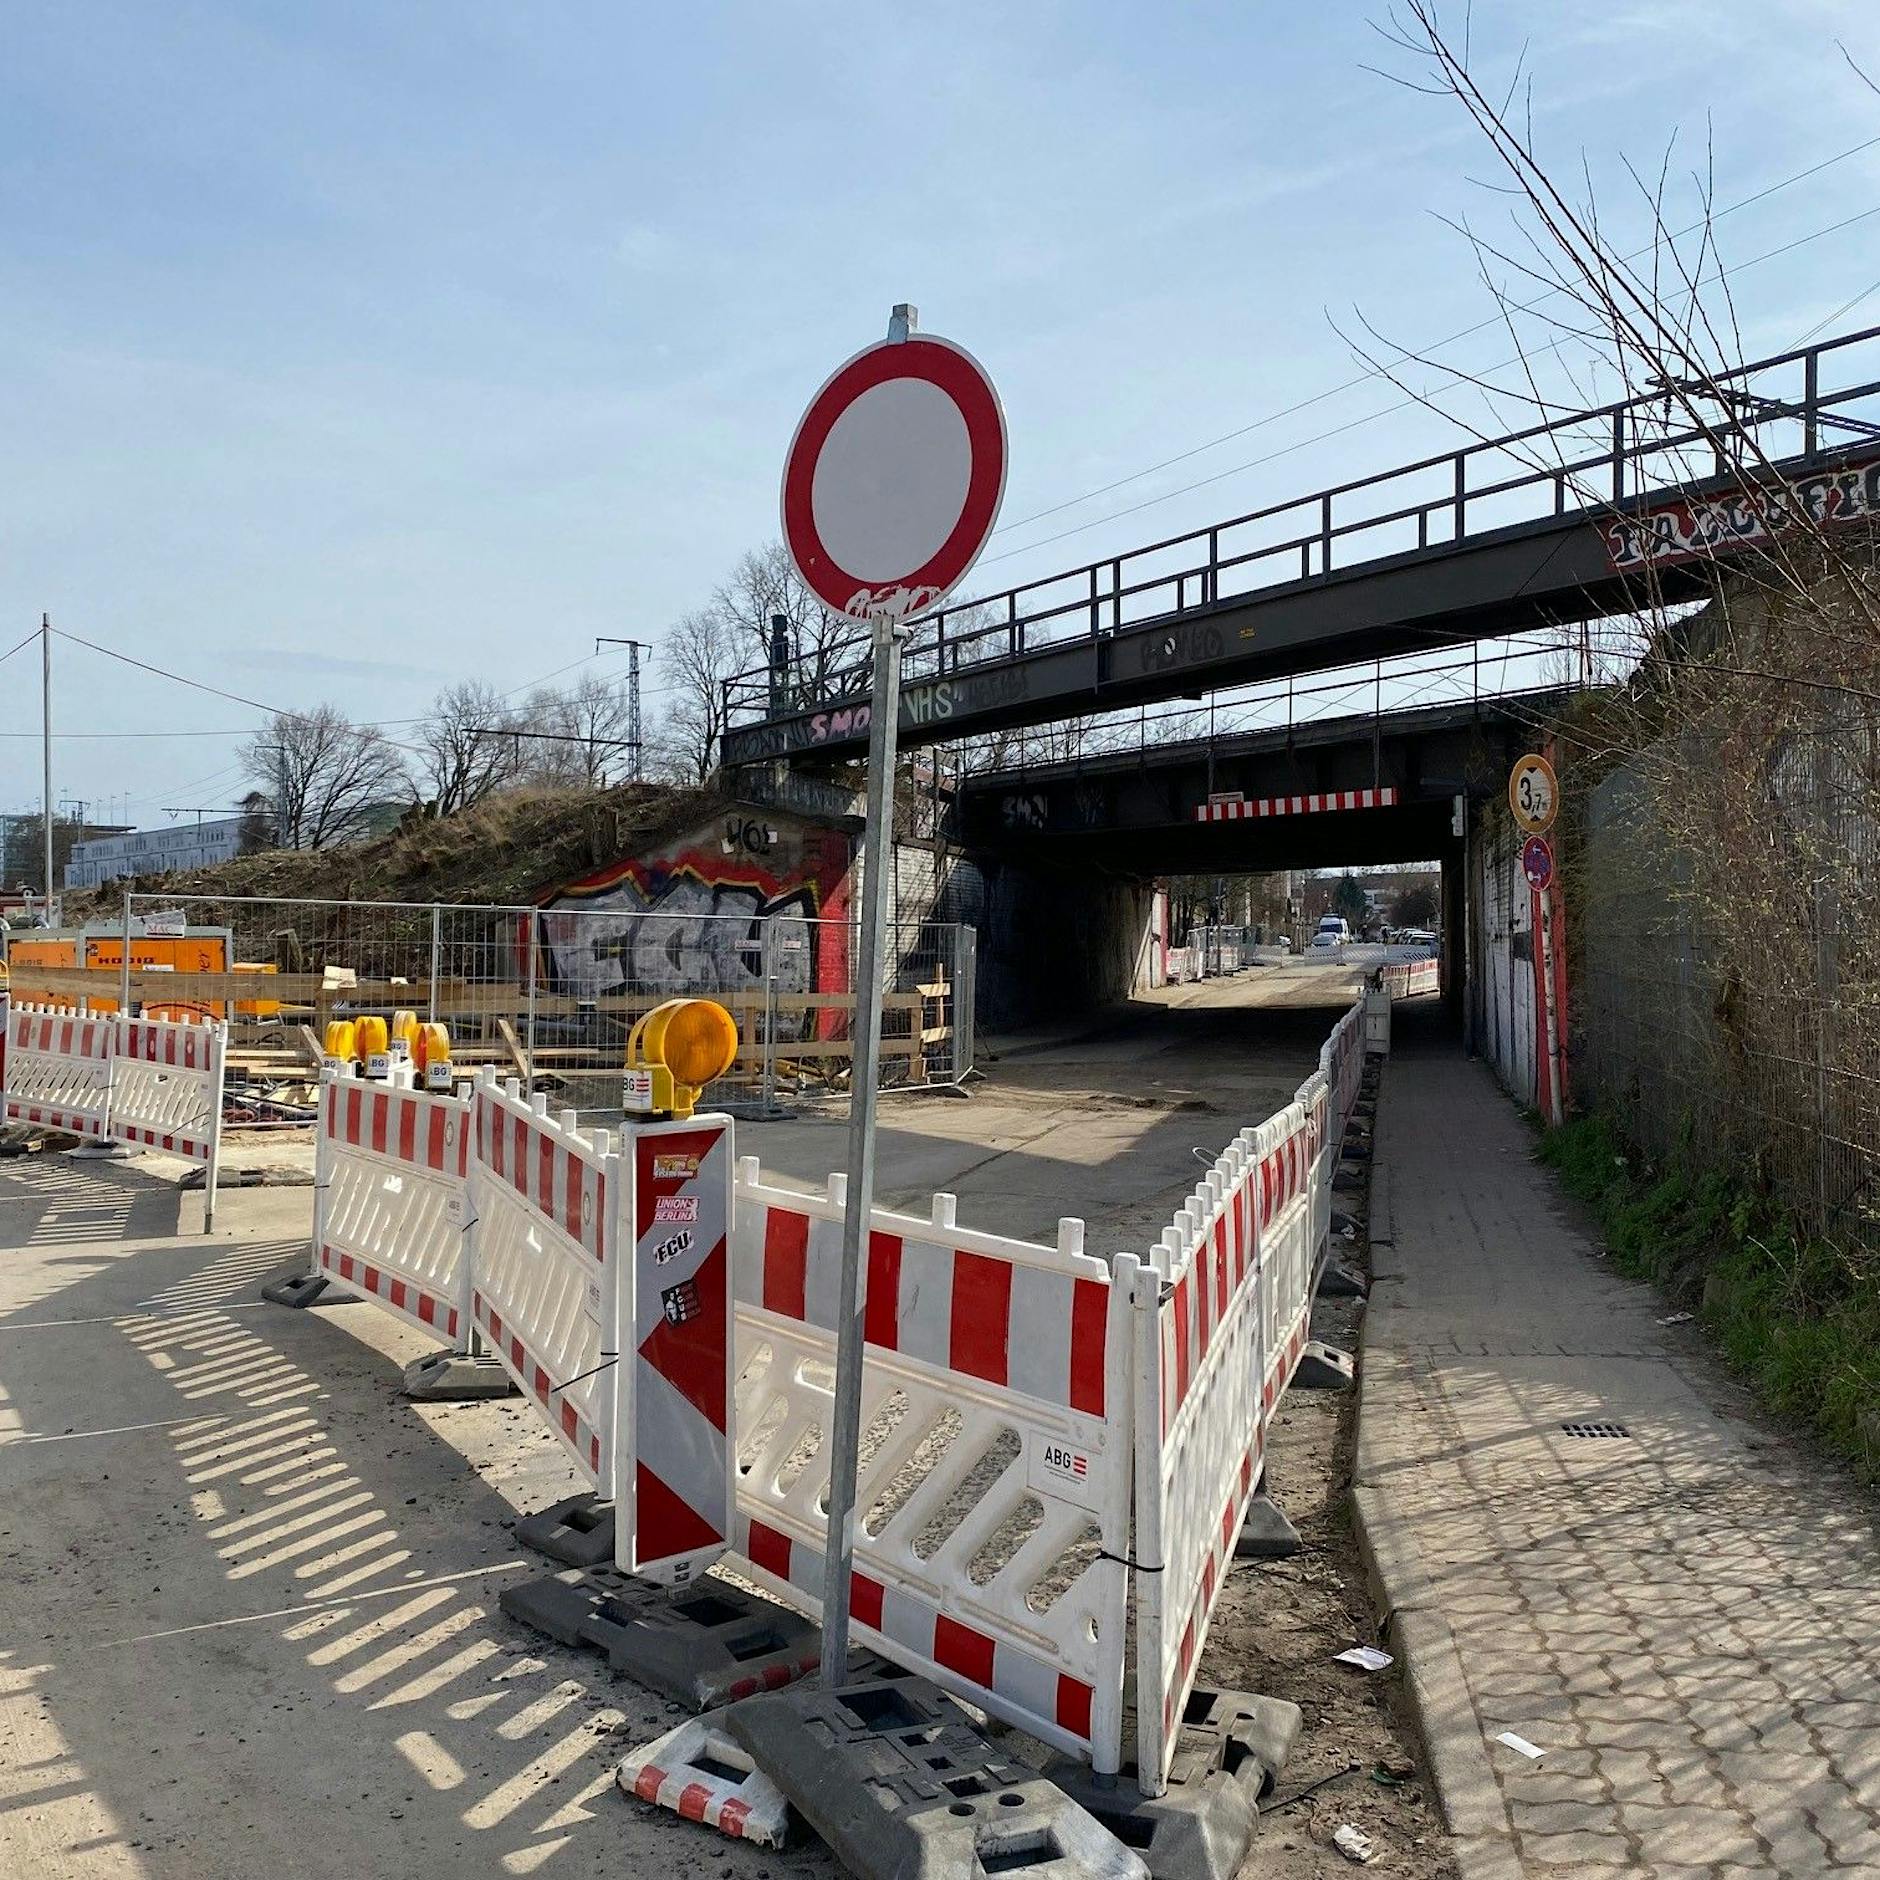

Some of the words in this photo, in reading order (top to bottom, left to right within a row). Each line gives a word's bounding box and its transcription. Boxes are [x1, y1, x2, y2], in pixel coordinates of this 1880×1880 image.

[656, 1198, 688, 1209] UNION
[655, 1210, 688, 1221] BERLIN
[1044, 1445, 1072, 1469] ABG
